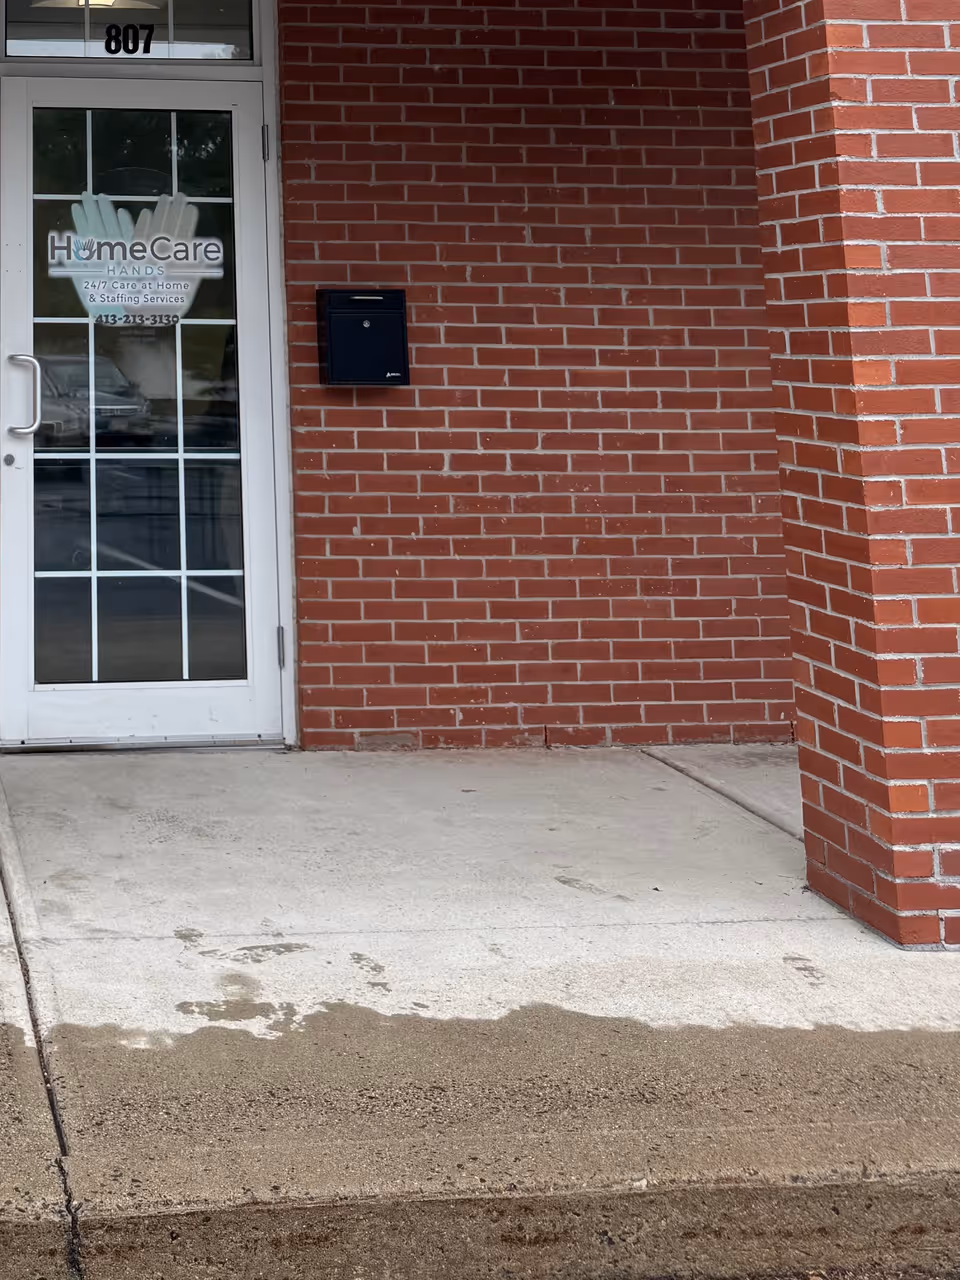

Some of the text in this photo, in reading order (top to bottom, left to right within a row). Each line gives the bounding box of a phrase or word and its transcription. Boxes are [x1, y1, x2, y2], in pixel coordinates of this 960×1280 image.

[104, 23, 155, 55] 807
[107, 265, 165, 276] HANDS
[84, 280, 190, 290] 24/7 Care at Home
[88, 293, 185, 304] & Staffing Services
